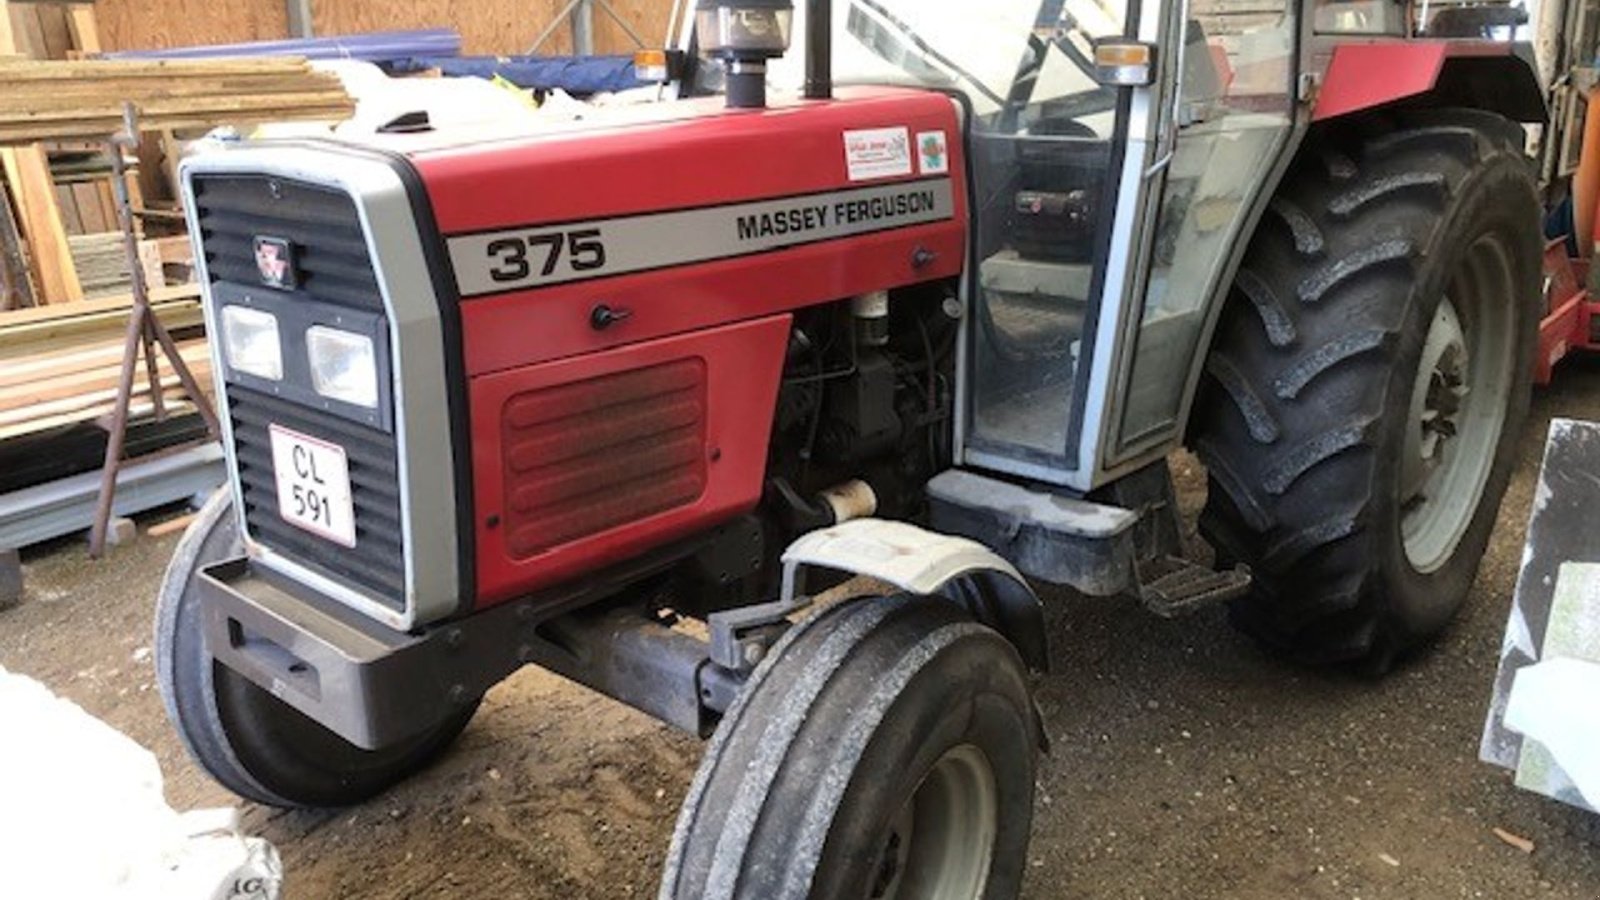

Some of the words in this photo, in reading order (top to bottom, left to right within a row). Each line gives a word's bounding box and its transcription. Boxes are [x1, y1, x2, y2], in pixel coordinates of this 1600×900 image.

[737, 206, 828, 239] MASSEY
[834, 191, 934, 225] FERGUSON
[487, 229, 606, 281] 375
[293, 444, 325, 485] CL
[293, 484, 331, 528] 591
